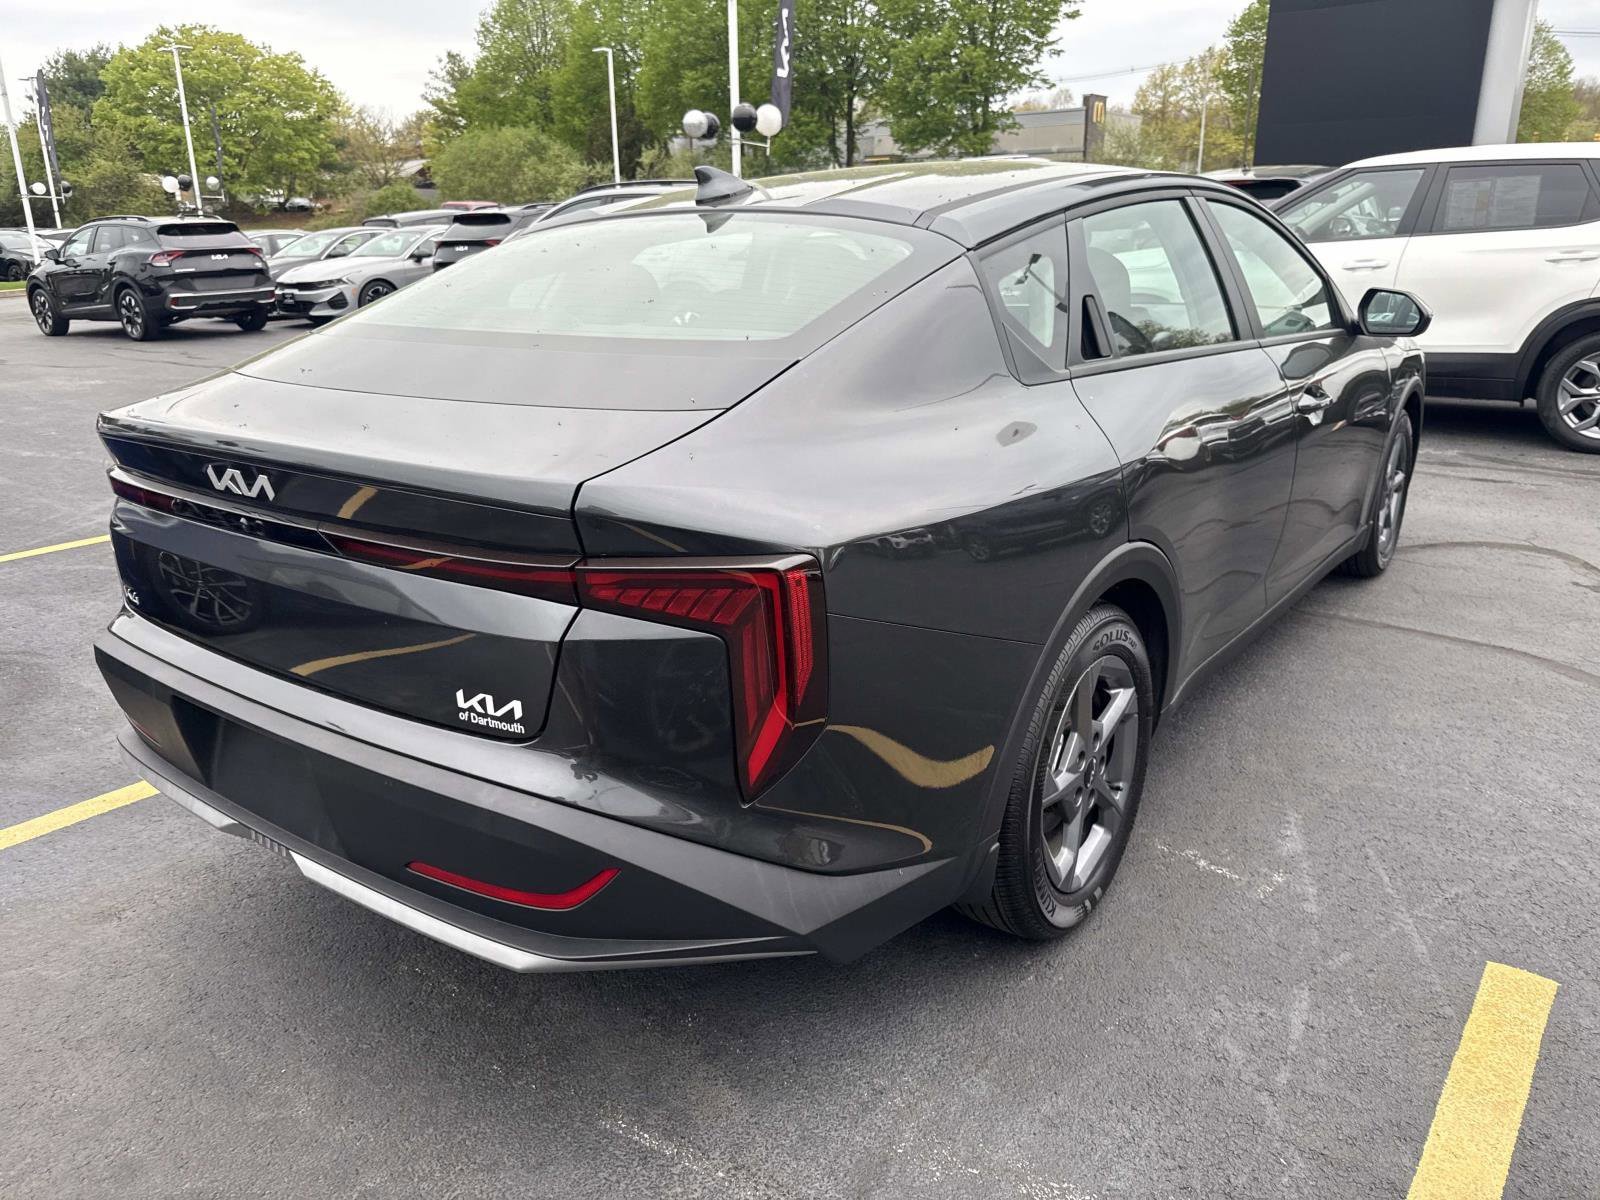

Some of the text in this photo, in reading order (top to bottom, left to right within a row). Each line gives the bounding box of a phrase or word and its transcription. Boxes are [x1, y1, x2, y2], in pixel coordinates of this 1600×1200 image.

[206, 464, 276, 501] KIA
[1093, 629, 1130, 651] SOLUS
[455, 688, 523, 721] KIA
[458, 711, 525, 734] of Dartmouth
